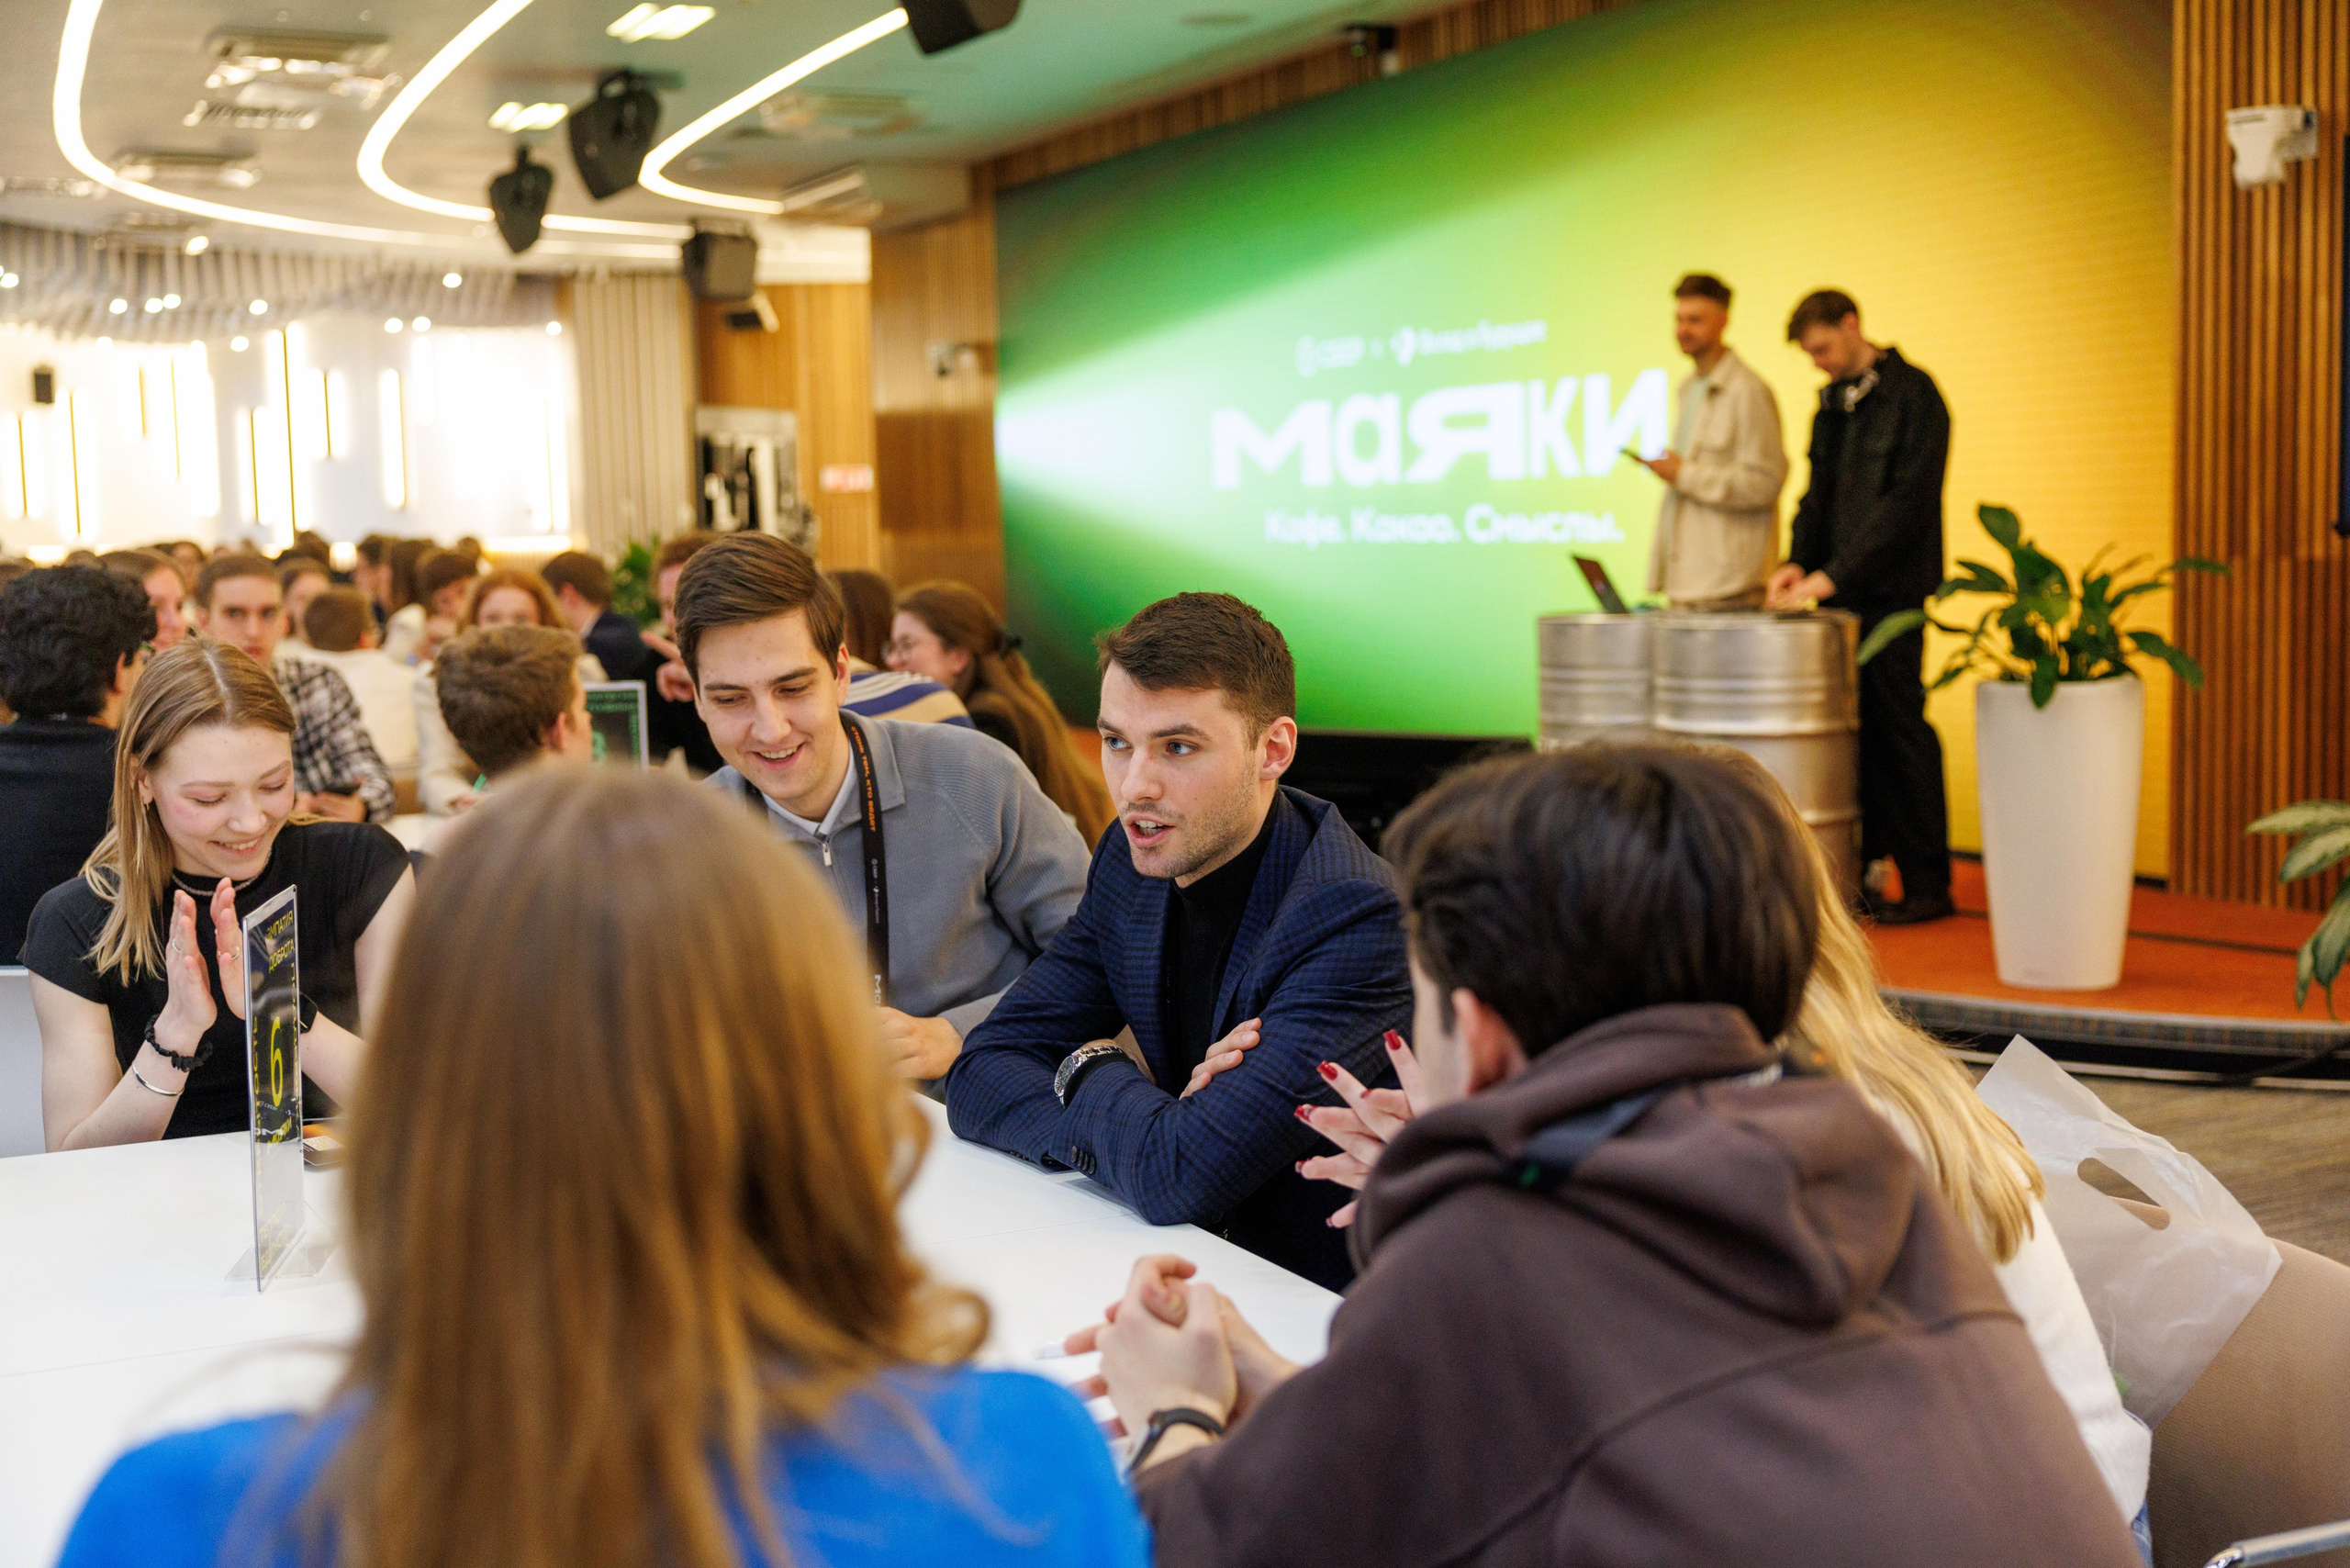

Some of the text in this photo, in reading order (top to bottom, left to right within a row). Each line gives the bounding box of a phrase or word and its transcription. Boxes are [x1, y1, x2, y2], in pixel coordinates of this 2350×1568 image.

[1464, 502, 1625, 544] Смыслы.
[269, 939, 295, 973] ДОБРОТА
[270, 1016, 284, 1107] 6
